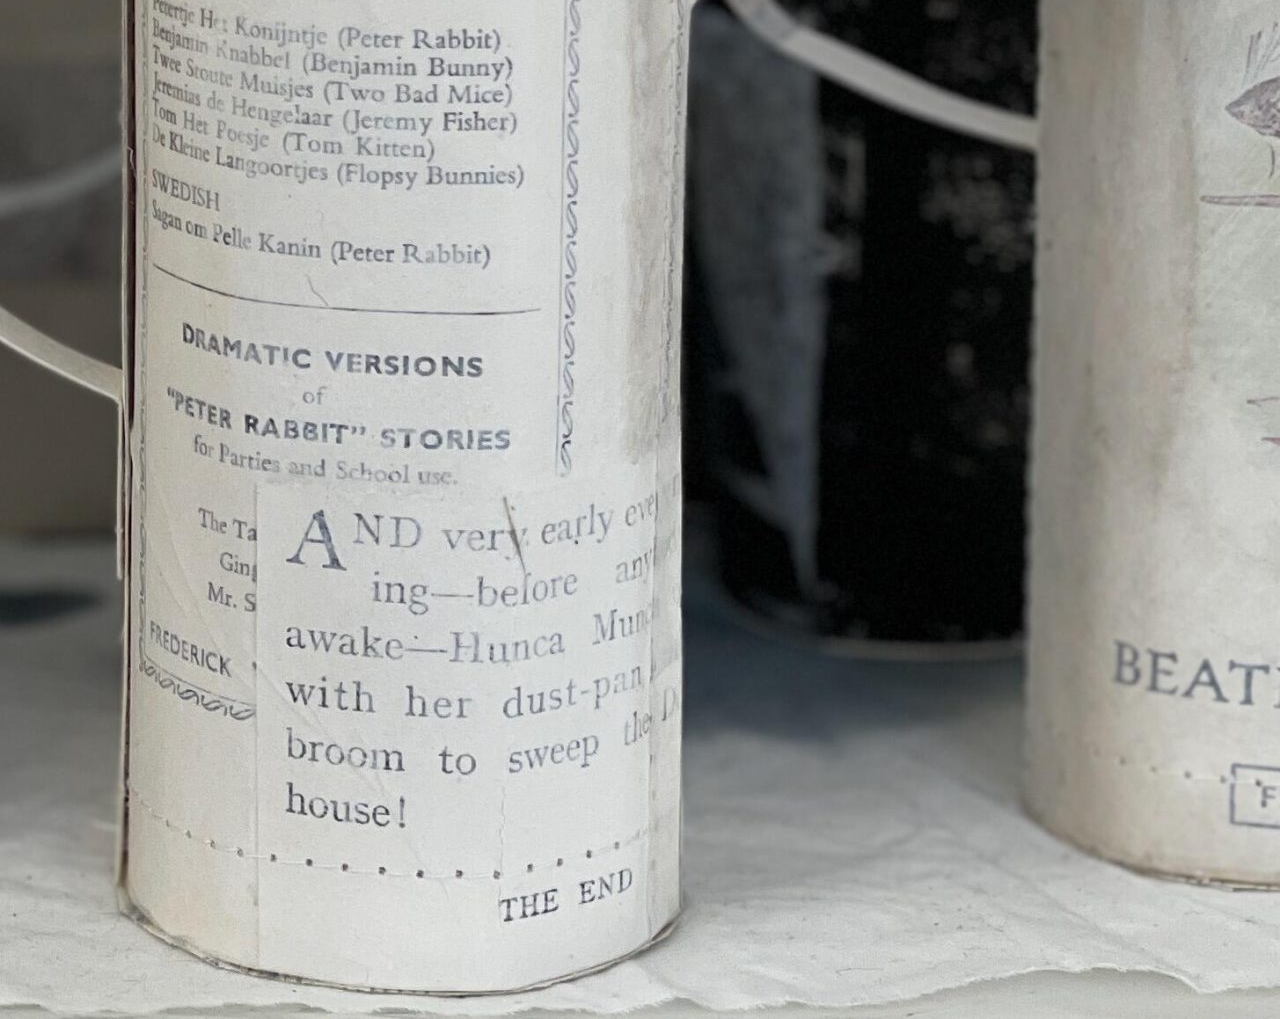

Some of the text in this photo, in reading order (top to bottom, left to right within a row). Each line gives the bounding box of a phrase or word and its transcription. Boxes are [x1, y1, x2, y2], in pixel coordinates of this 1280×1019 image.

[152, 16, 209, 54] Benjamin
[303, 51, 418, 80] (Benjamin
[427, 55, 513, 82] Bunny)
[338, 26, 404, 52] (Peter
[412, 28, 501, 54] Rabbit)
[152, 44, 182, 74] Twee
[239, 69, 315, 103] Muisjes
[322, 81, 386, 106] (Two
[395, 83, 439, 104] Bad
[447, 83, 513, 108] Mice)
[152, 97, 178, 126] Tom
[183, 109, 210, 135] Het
[282, 131, 343, 156] (Tom
[355, 135, 436, 164] Kitten)
[207, 89, 226, 112] de
[231, 95, 334, 128] Hengelaar
[342, 108, 433, 137] (Jeremy
[441, 111, 518, 135] Fisher)
[152, 122, 525, 190] De Kleine Langoortjes (Flopsy Bunnies)
[152, 167, 221, 212] SWEDISH
[152, 198, 492, 270] Sagan om Pelle Kanin (Peter Rabbit)
[182, 321, 485, 379] DRAMATIC VERSIONS
[302, 386, 328, 406] of
[193, 433, 460, 487] for Parties and School use.
[379, 427, 512, 452] STORIES
[198, 506, 228, 535] The
[285, 508, 422, 572] AND
[440, 525, 529, 562] very
[540, 502, 615, 545] early
[207, 580, 238, 609] Mr.
[149, 619, 233, 678] FREDERICK
[1113, 638, 1280, 710] BEAT
[285, 665, 643, 720] with her dust-pan
[285, 727, 406, 773] broom
[438, 745, 478, 776] to
[507, 734, 600, 774] sweep
[285, 781, 407, 830] house!
[501, 867, 634, 923] THE END
